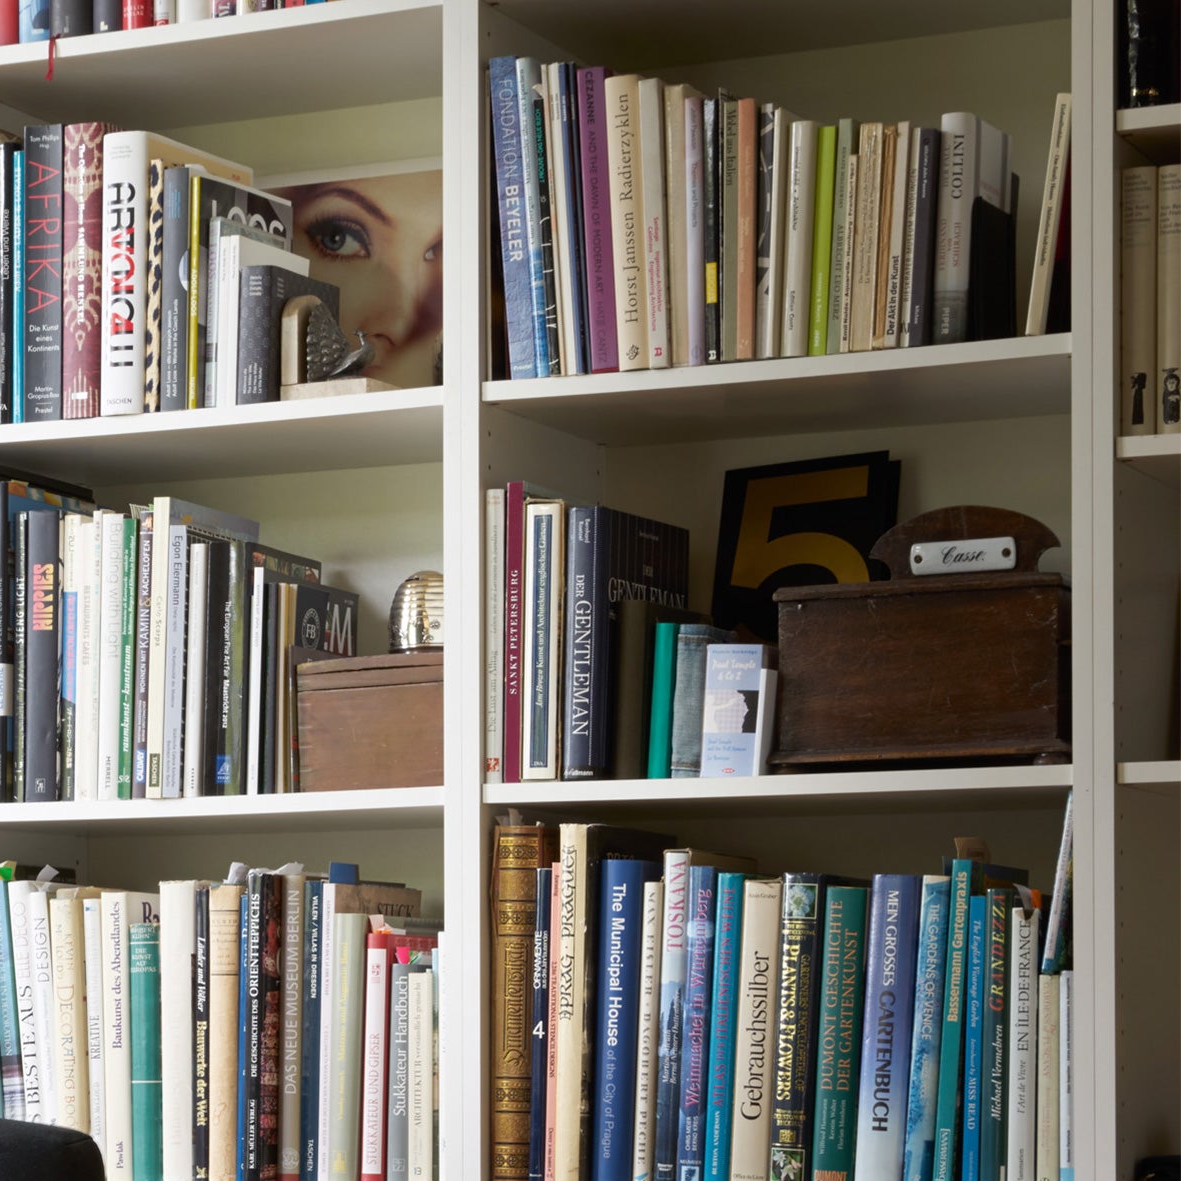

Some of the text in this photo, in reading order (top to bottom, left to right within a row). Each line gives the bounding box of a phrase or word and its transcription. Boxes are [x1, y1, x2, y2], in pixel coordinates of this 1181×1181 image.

[500, 79, 523, 262] FONDATION BEYELER
[584, 71, 603, 272] CÉZANNE MODERN
[616, 94, 640, 323] Horst Janssen Radierzyklen
[726, 157, 737, 186] Italien
[951, 133, 965, 199] COLLINI
[27, 160, 60, 313] AFRIKA
[77, 228, 86, 325] SAMMLUNG HENKEL
[832, 224, 844, 320] ALBRECHT LEO MERZ
[890, 255, 899, 279] Kunst
[952, 222, 961, 267] SCHIRACH
[887, 320, 896, 335] Der
[888, 304, 896, 319] Akt
[889, 281, 898, 295] der
[941, 308, 951, 335] PIPER
[171, 535, 182, 605] Egon Eiermann
[729, 463, 871, 590] 5
[32, 564, 54, 630] HIPPIES
[105, 523, 123, 659] Building with Light
[139, 540, 151, 648] KAMIN KACHELOFEN
[223, 613, 231, 640] European
[224, 601, 232, 612] The
[509, 569, 519, 694] SANKT PETERSBURG
[121, 644, 133, 752] raumkunst kunstraum
[222, 680, 230, 713] Maastricht
[223, 668, 231, 678] Fair
[572, 575, 592, 736] DER GENTLEMAN
[34, 918, 50, 983] DESIGN
[249, 894, 261, 997] ORIENTTEPPICHS
[310, 927, 319, 954] VILLAS
[666, 861, 687, 952] TOSKANA
[947, 872, 970, 1022] Bassermann Gartenpraxis
[110, 902, 122, 1049] Baukunst des Abendlandes
[251, 1000, 259, 1013] DES
[284, 889, 301, 1094] DAS NEUE MUSEUM BERLIN
[310, 955, 317, 963] IN
[533, 931, 542, 989] ORNAMENTE
[685, 889, 711, 1107] Weinmacher in Württemberg
[820, 901, 843, 1090] DUMONT GESCHICHTE
[921, 904, 940, 1040] THE GARDENS VENICE
[0, 996, 13, 1056] DECORATION
[20, 985, 41, 1105] BESTE AUS
[195, 968, 208, 1126] und Bauwerke der Welt
[251, 1015, 259, 1062] GESCHICHTE
[393, 977, 409, 1116] Stukkateur Handbuch
[533, 1020, 545, 1039] 4
[602, 884, 627, 1158] The Municipal House of the City of Prague
[740, 951, 770, 1119] Gebrauchssilber
[775, 944, 800, 1099] PLANTS FLOWERS
[836, 929, 858, 1090] DER GARTENKUNST
[872, 890, 900, 1131] MEIN GROSSES GARTENBUCH
[987, 895, 1006, 1120] Michael GRANDEZZA
[1017, 1033, 1030, 1052] EN
[640, 1013, 652, 1101] DAGOBERT
[712, 1063, 726, 1107] ATLAS
[967, 1076, 977, 1129] MISS READ
